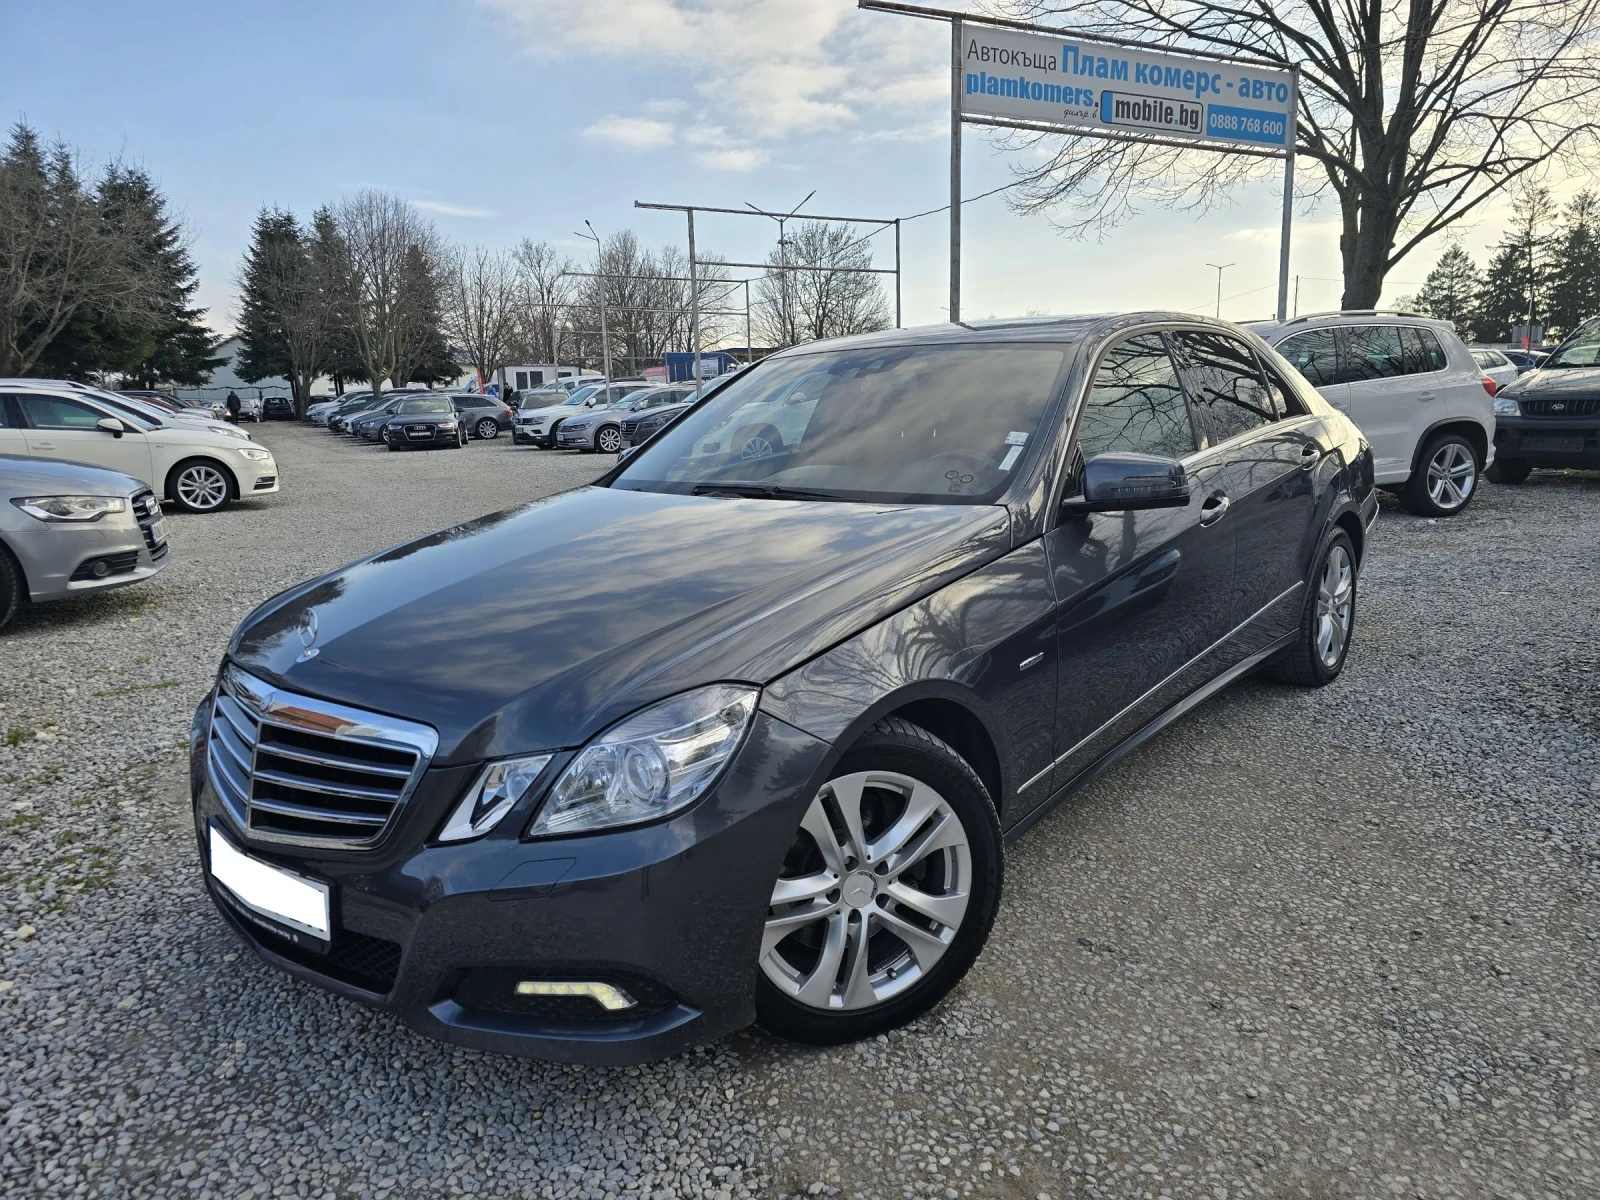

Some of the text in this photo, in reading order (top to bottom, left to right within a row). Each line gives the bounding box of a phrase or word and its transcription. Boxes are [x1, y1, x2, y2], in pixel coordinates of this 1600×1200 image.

[967, 39, 1057, 74] Автокъща
[1062, 44, 1129, 82] Плам
[1135, 62, 1222, 99] комерс
[1238, 77, 1289, 103] авто
[1115, 99, 1199, 130] mobile.bg
[1210, 113, 1283, 136] 0888 768 600
